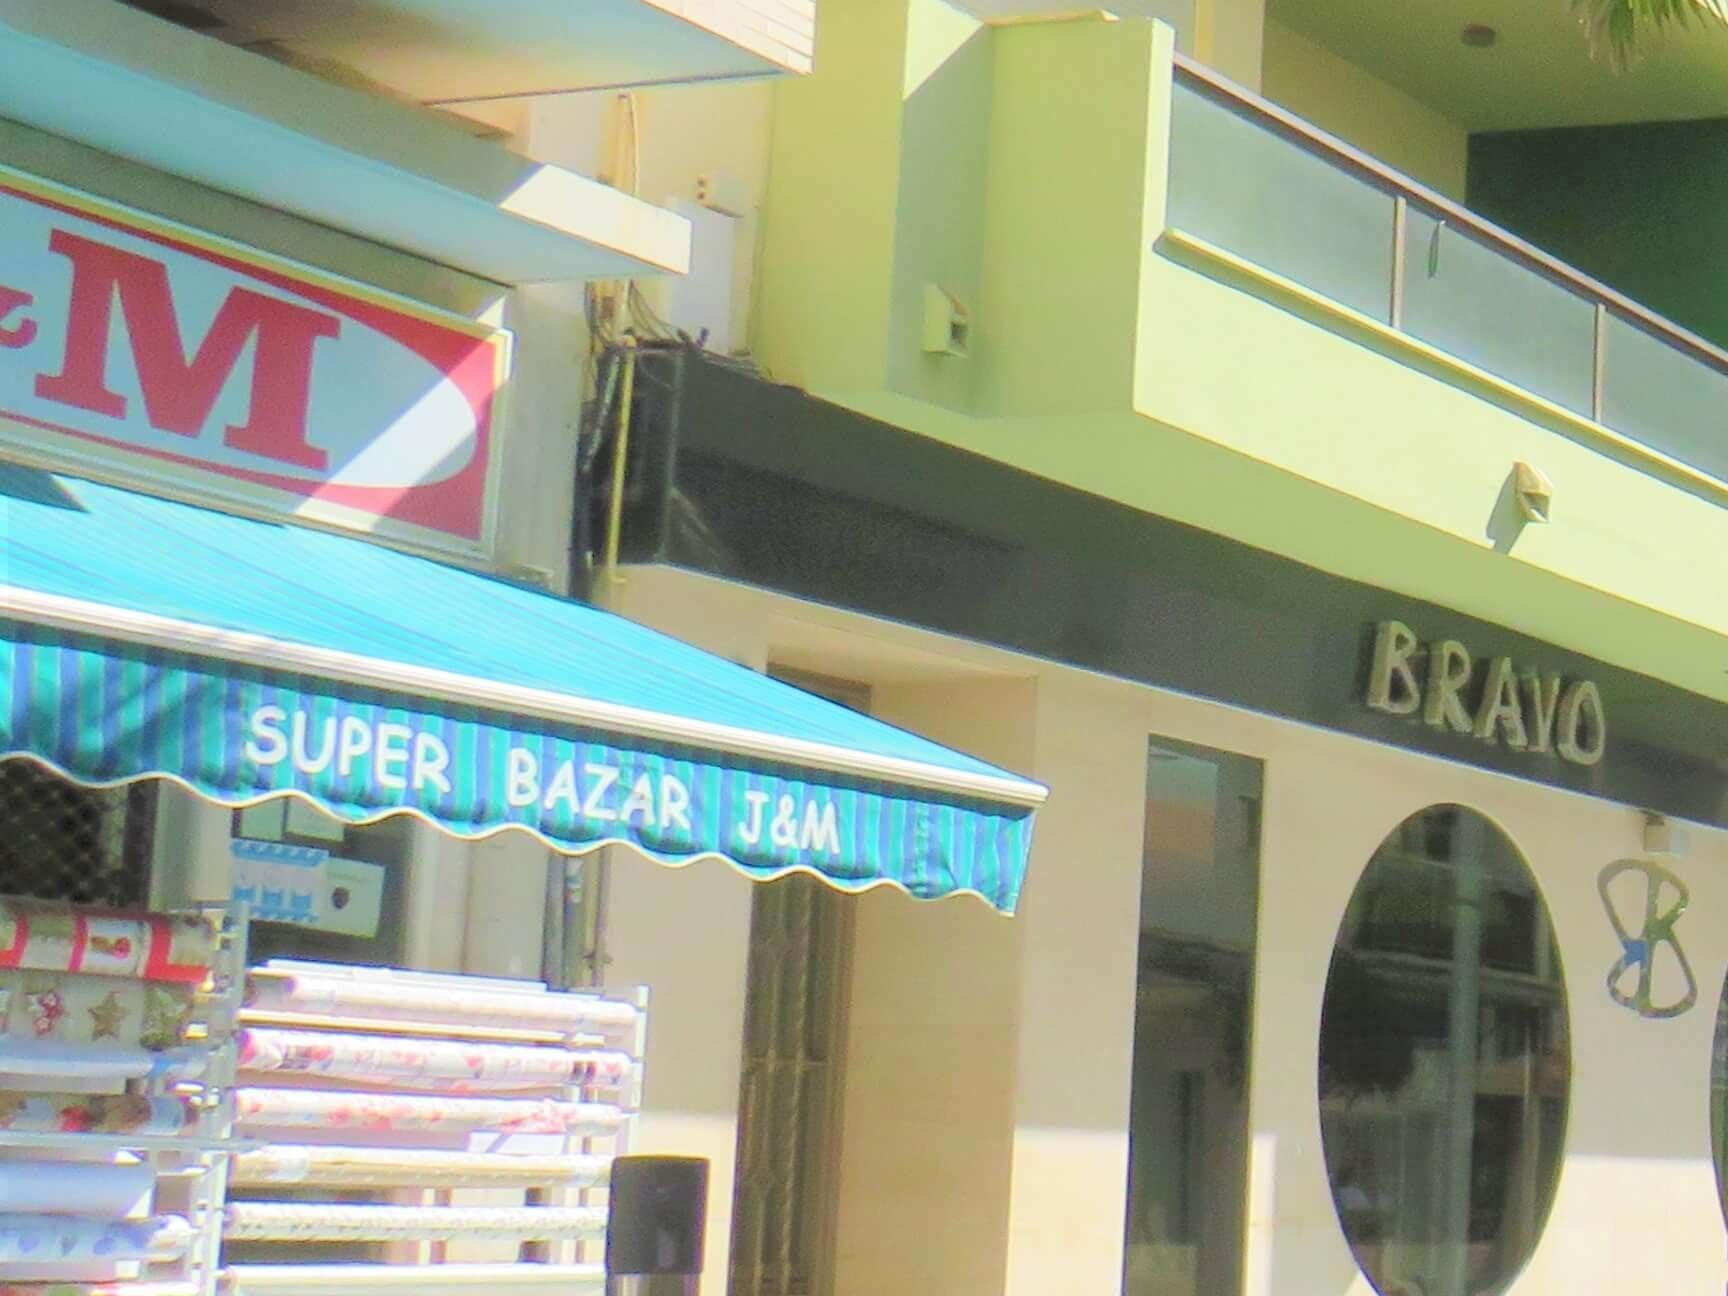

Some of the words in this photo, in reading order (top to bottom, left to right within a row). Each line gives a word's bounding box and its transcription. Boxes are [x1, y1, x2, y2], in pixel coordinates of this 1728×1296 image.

[1367, 619, 1606, 766] BRAVO
[245, 706, 453, 794] SUPER
[506, 746, 691, 831] BAZAR
[737, 789, 842, 855] J&M
